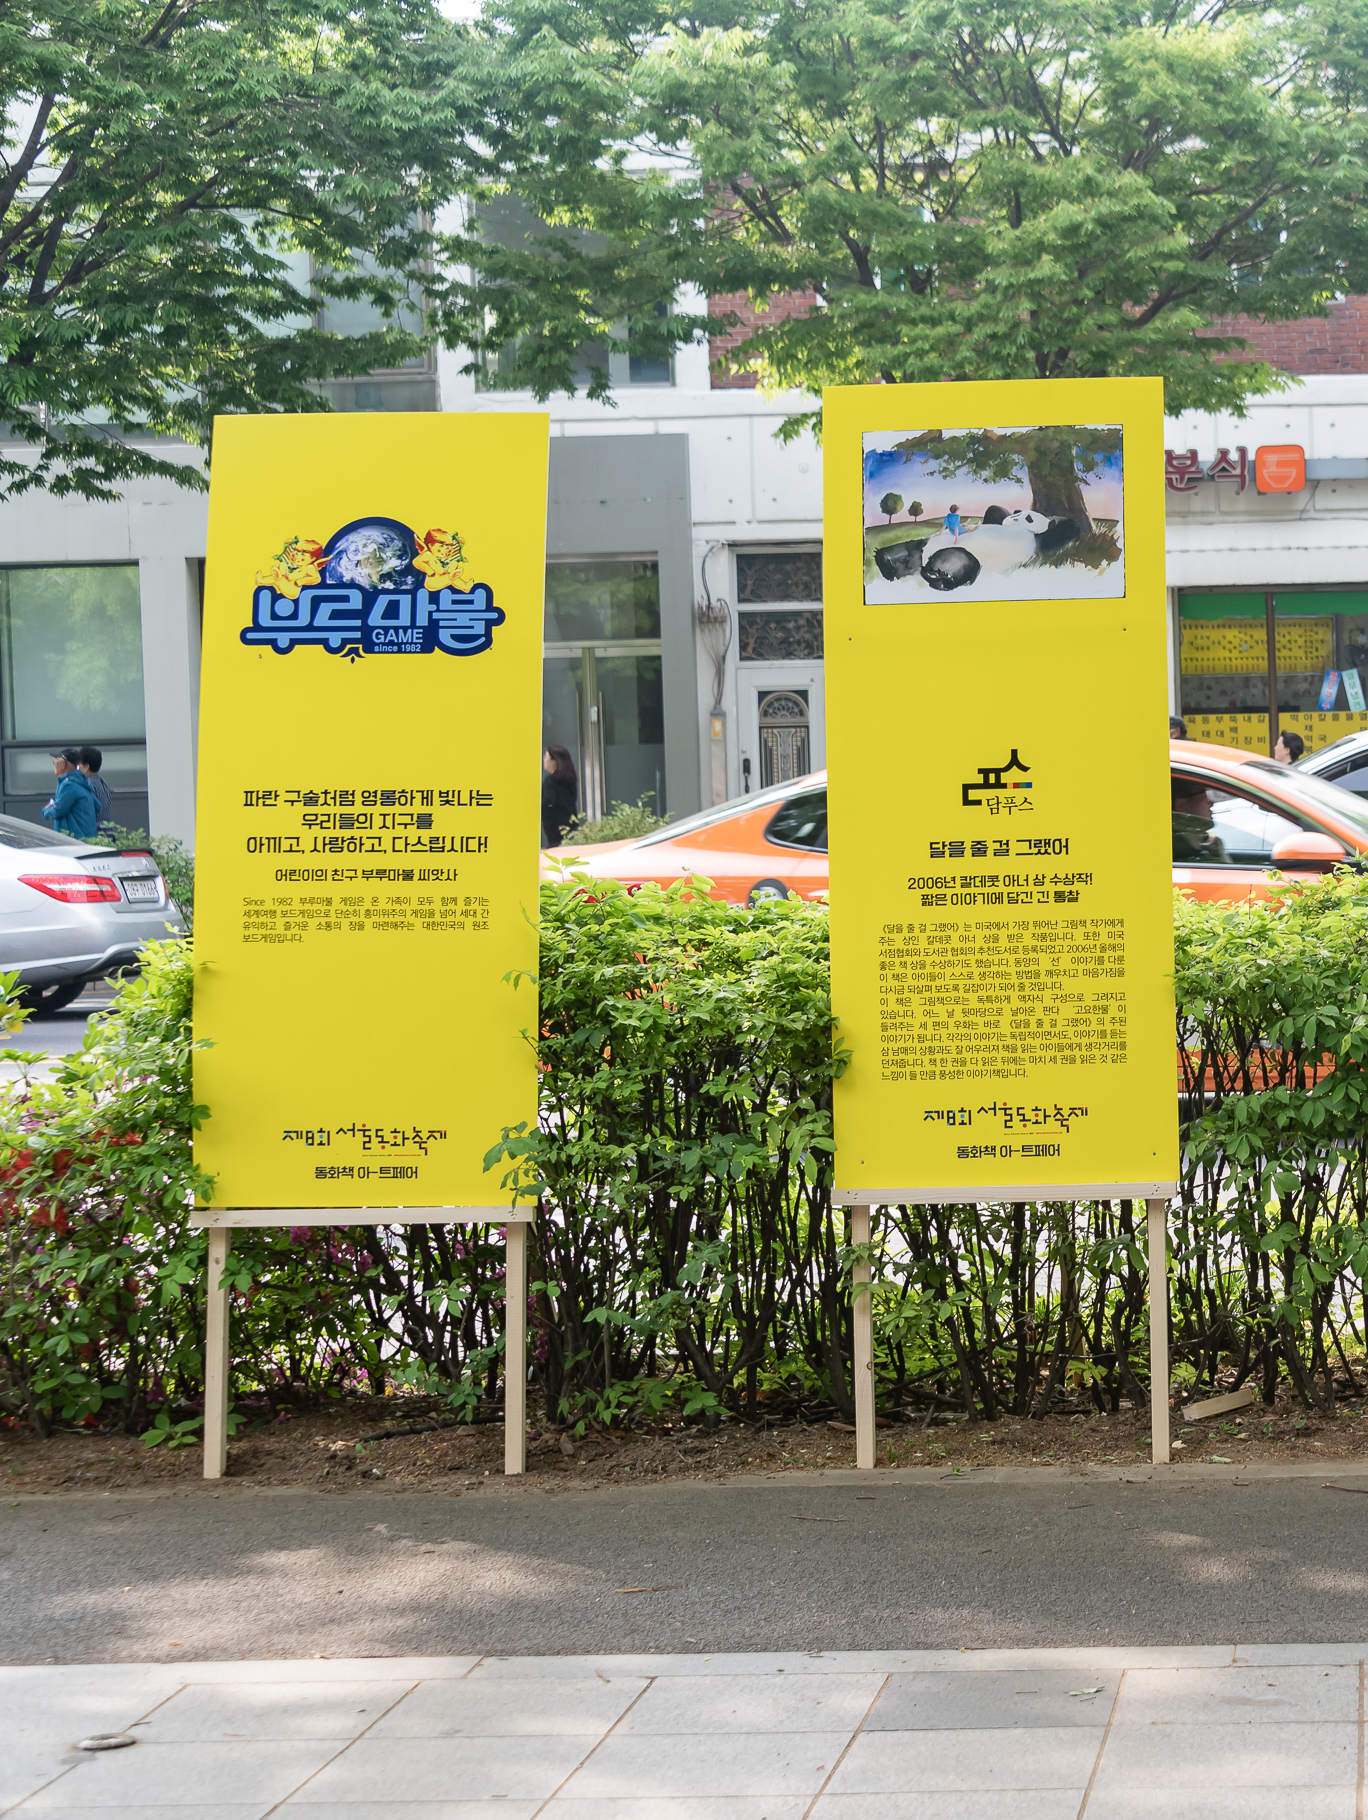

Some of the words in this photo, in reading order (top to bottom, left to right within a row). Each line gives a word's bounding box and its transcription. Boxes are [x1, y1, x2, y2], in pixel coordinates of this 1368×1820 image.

[246, 588, 498, 649] 부루마불
[372, 629, 423, 643] GAME
[374, 644, 398, 652] since
[401, 644, 421, 652] 1982
[243, 790, 280, 807] 파란
[284, 789, 356, 806] 구술처럼
[361, 789, 434, 806] 영롱하게
[438, 790, 494, 806] 빛나는
[986, 795, 1034, 816] 담푸스
[302, 813, 374, 830] 우리들의
[378, 813, 434, 830] 지구를
[247, 836, 305, 854] 아끼고,
[310, 836, 387, 854] 사랑하고,
[392, 836, 488, 853] 다스립시다!
[930, 840, 966, 858] 달을
[970, 840, 989, 857] 줄
[992, 839, 1010, 857] 걸
[1015, 838, 1069, 857] 그랬어
[276, 869, 328, 881] 어린이의
[331, 868, 358, 881] 친구
[361, 869, 415, 881] 부루마불
[418, 869, 458, 881] 씨앗사
[908, 876, 956, 890] 2006년
[960, 875, 1000, 889] 칼데콧
[1003, 874, 1029, 887] 아너
[1033, 874, 1046, 886] 상
[1049, 872, 1092, 886] 수상작!
[243, 897, 265, 906] Since
[272, 898, 293, 906] 1982
[299, 897, 333, 906] 부루마불
[339, 897, 364, 906] 게임은
[371, 897, 379, 906] 온
[386, 897, 411, 906] 가족이
[417, 897, 434, 906] 모두
[441, 897, 457, 906] 함께
[464, 897, 489, 906] 즐기는
[921, 893, 948, 907] 짧은
[951, 892, 1004, 906] 이야기에
[1007, 891, 1033, 904] 담긴
[1036, 891, 1049, 904] 긴
[1053, 889, 1080, 903] 통찰
[243, 909, 277, 919] 세계여행
[280, 909, 331, 918] 보드게임으로
[335, 909, 360, 918] 단순히
[364, 909, 406, 919] 흥미위주의
[410, 909, 436, 918] 게임을
[440, 909, 456, 918] 넘어
[460, 909, 477, 918] 세대
[481, 909, 489, 918] 간
[243, 922, 276, 930] 유익하고
[284, 921, 309, 931] 즐거운
[316, 921, 341, 931] 소통의
[348, 921, 365, 931] 장을
[372, 921, 415, 930] 마련해주는
[422, 921, 464, 930] 대한민국의
[472, 921, 489, 930] 원조
[907, 924, 915, 933] 줄
[919, 923, 926, 933] 걸
[964, 922, 972, 932] 는
[976, 921, 1009, 931] 미국에서
[1013, 921, 1029, 931] 가장
[1033, 920, 1058, 930] 뛰어난
[1061, 919, 1086, 930] 그림책
[1090, 918, 1124, 929] 작가에게
[242, 934, 304, 943] 보드게임입니다.
[923, 947, 948, 957] 도서관
[1067, 943, 1097, 954] 2006년
[1099, 943, 1124, 953] 올해의
[879, 961, 896, 971] 좋은
[899, 961, 907, 970] 책
[910, 960, 927, 970] 상을
[930, 959, 972, 970] 수상하기도
[975, 958, 1011, 968] 했습니다.
[1014, 957, 1039, 967] 동양의
[1071, 956, 1105, 966] 이야기를
[1108, 955, 1125, 965] 다룬
[880, 973, 887, 983] 이
[892, 973, 908, 983] 책은
[912, 972, 945, 982] 아이들이
[949, 971, 974, 980] 스스로
[978, 970, 1012, 981] 생각하는
[1016, 969, 1041, 980] 방법을
[1045, 968, 1079, 979] 깨우치고
[1083, 967, 1125, 978] 마음가짐을
[880, 985, 905, 995] 다시금
[935, 984, 960, 994] 보도록
[962, 983, 996, 993] 길잡이가
[999, 982, 1015, 992] 되어
[1017, 982, 1026, 992] 줄
[1028, 981, 1064, 992] 것입니다.
[880, 998, 888, 1007] 이
[896, 997, 912, 1007] 책은
[919, 996, 970, 1007] 그림책으로는
[1050, 993, 1085, 1004] 구성으로
[1092, 992, 1126, 1002] 그려지고
[880, 1009, 916, 1020] 있습니다.
[923, 1009, 940, 1018] 어느
[946, 1009, 954, 1018] 날
[1010, 1006, 1036, 1017] 날아온
[1043, 1006, 1060, 1016] 판다
[1118, 1004, 1126, 1014] 이
[880, 1022, 914, 1032] 들려주는
[919, 1021, 927, 1031] 세
[932, 1021, 948, 1030] 편의
[954, 1020, 979, 1030] 우화는
[984, 1020, 1001, 1029] 바로
[1036, 1019, 1044, 1028] 줄
[1049, 1018, 1057, 1028] 걸
[1096, 1017, 1104, 1026] 의
[1109, 1017, 1126, 1026] 주된
[882, 1071, 906, 1081] 느낌이
[909, 1071, 917, 1080] 들
[920, 1070, 936, 1080] 만큼
[966, 1068, 1028, 1079] 이야기책입니다.
[957, 1145, 997, 1159] 동화책
[315, 1166, 354, 1179] 동화책
